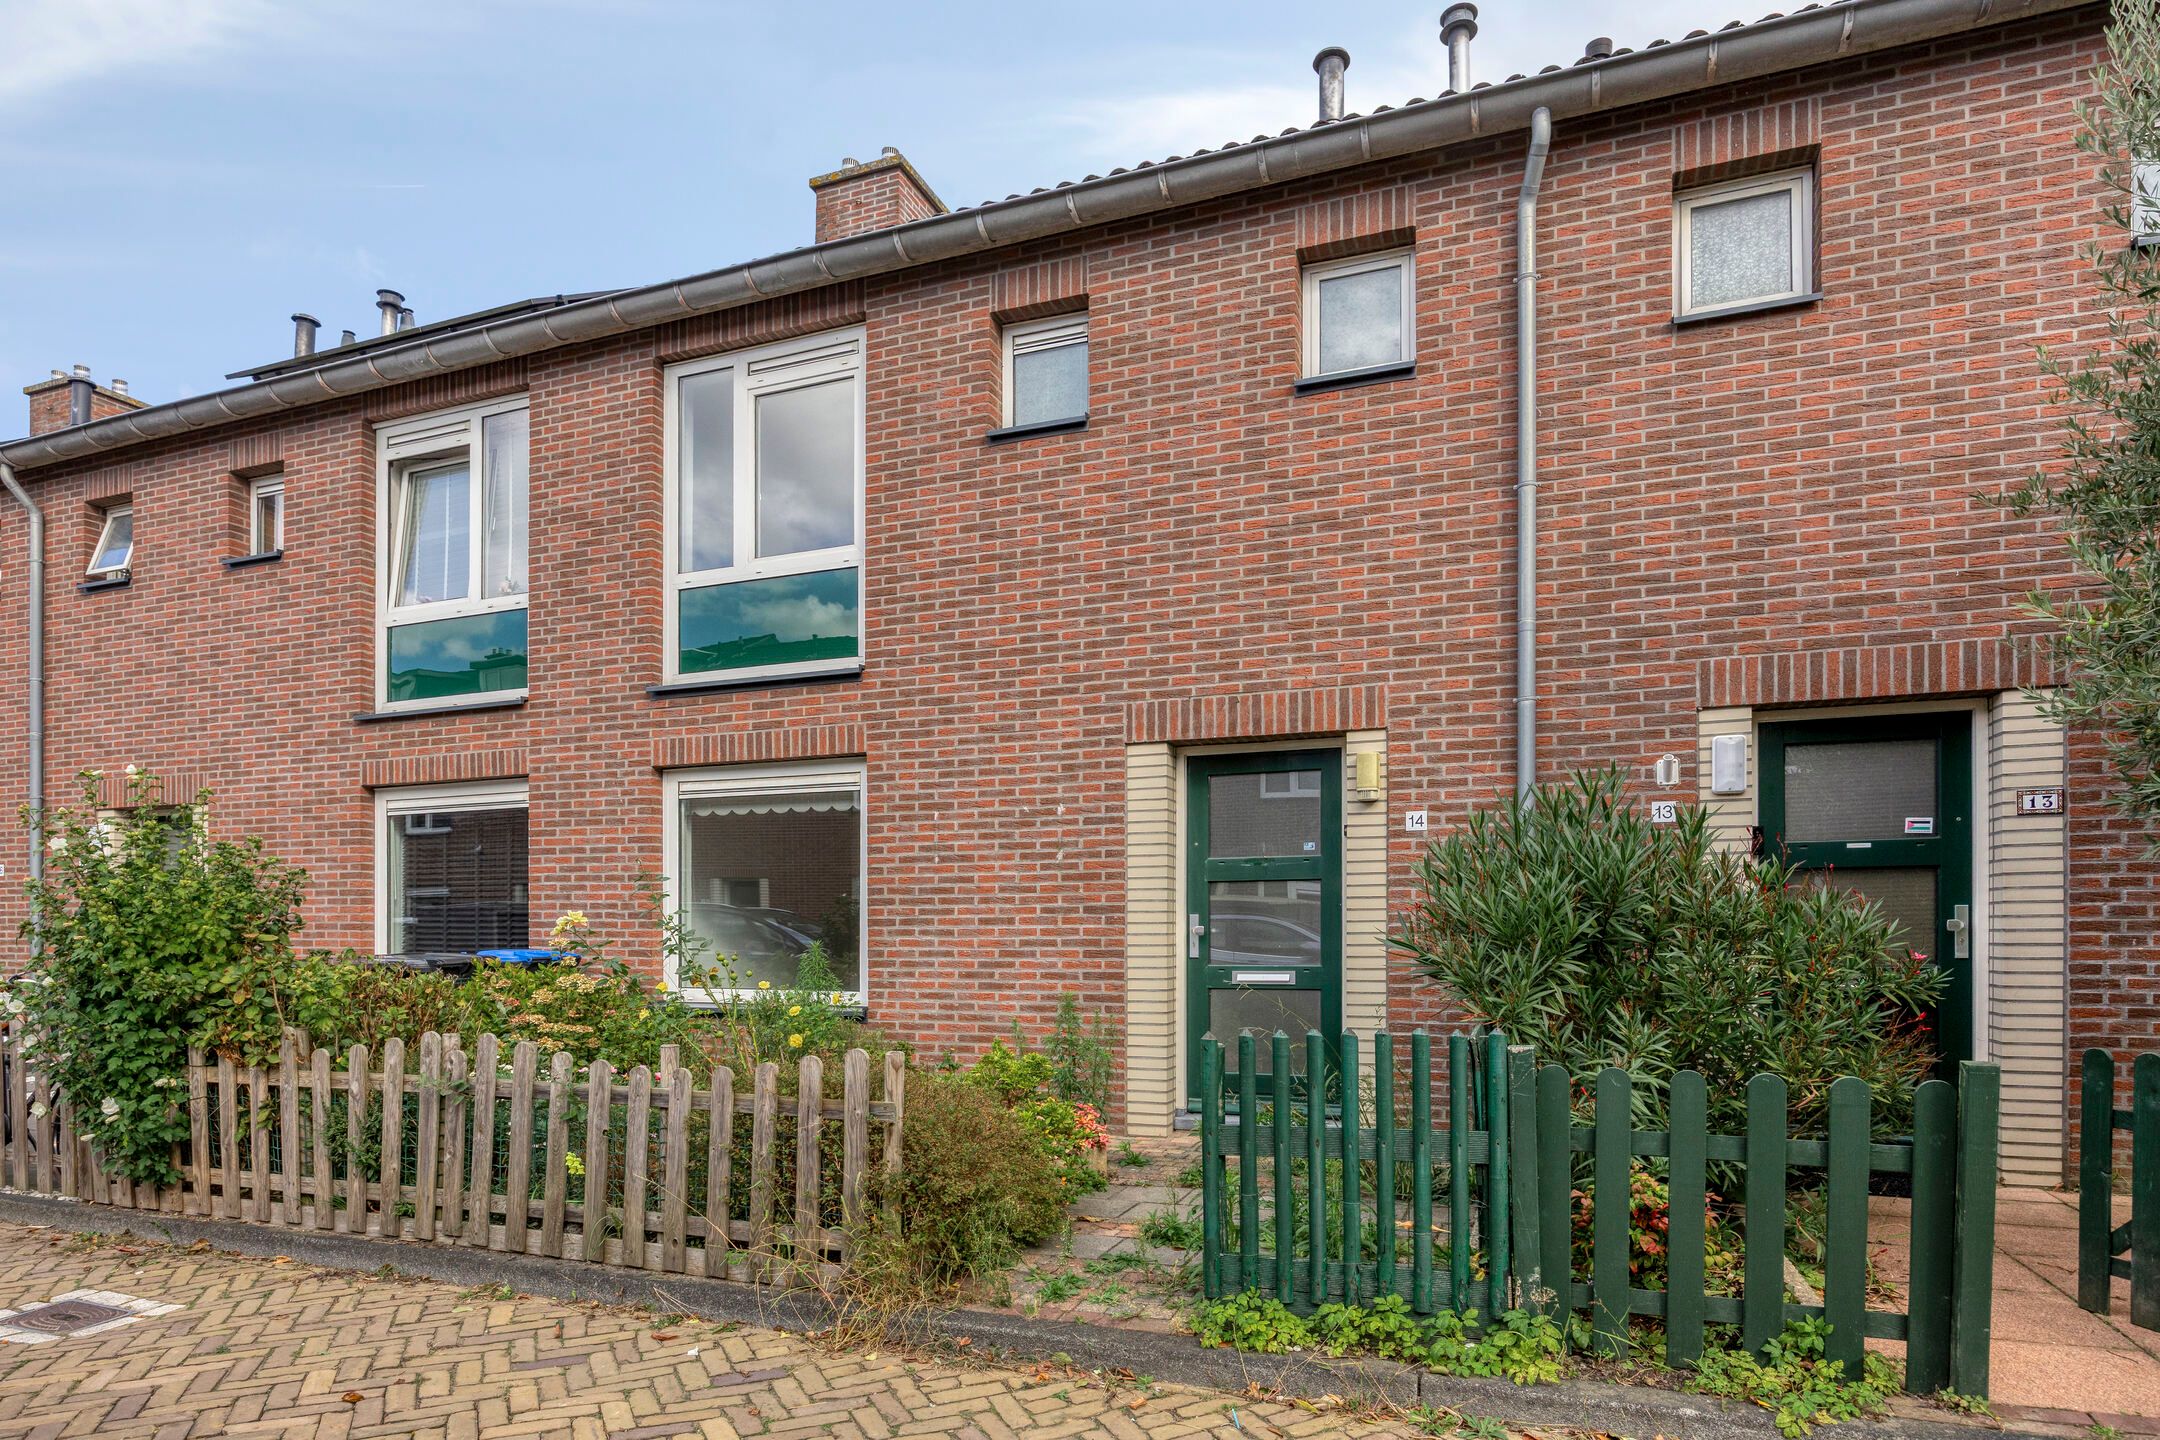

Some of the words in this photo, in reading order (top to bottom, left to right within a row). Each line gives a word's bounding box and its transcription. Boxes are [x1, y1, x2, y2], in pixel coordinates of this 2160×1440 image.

[2029, 795, 2053, 809] 13
[1654, 804, 1673, 819] 13
[1408, 814, 1425, 828] 14
